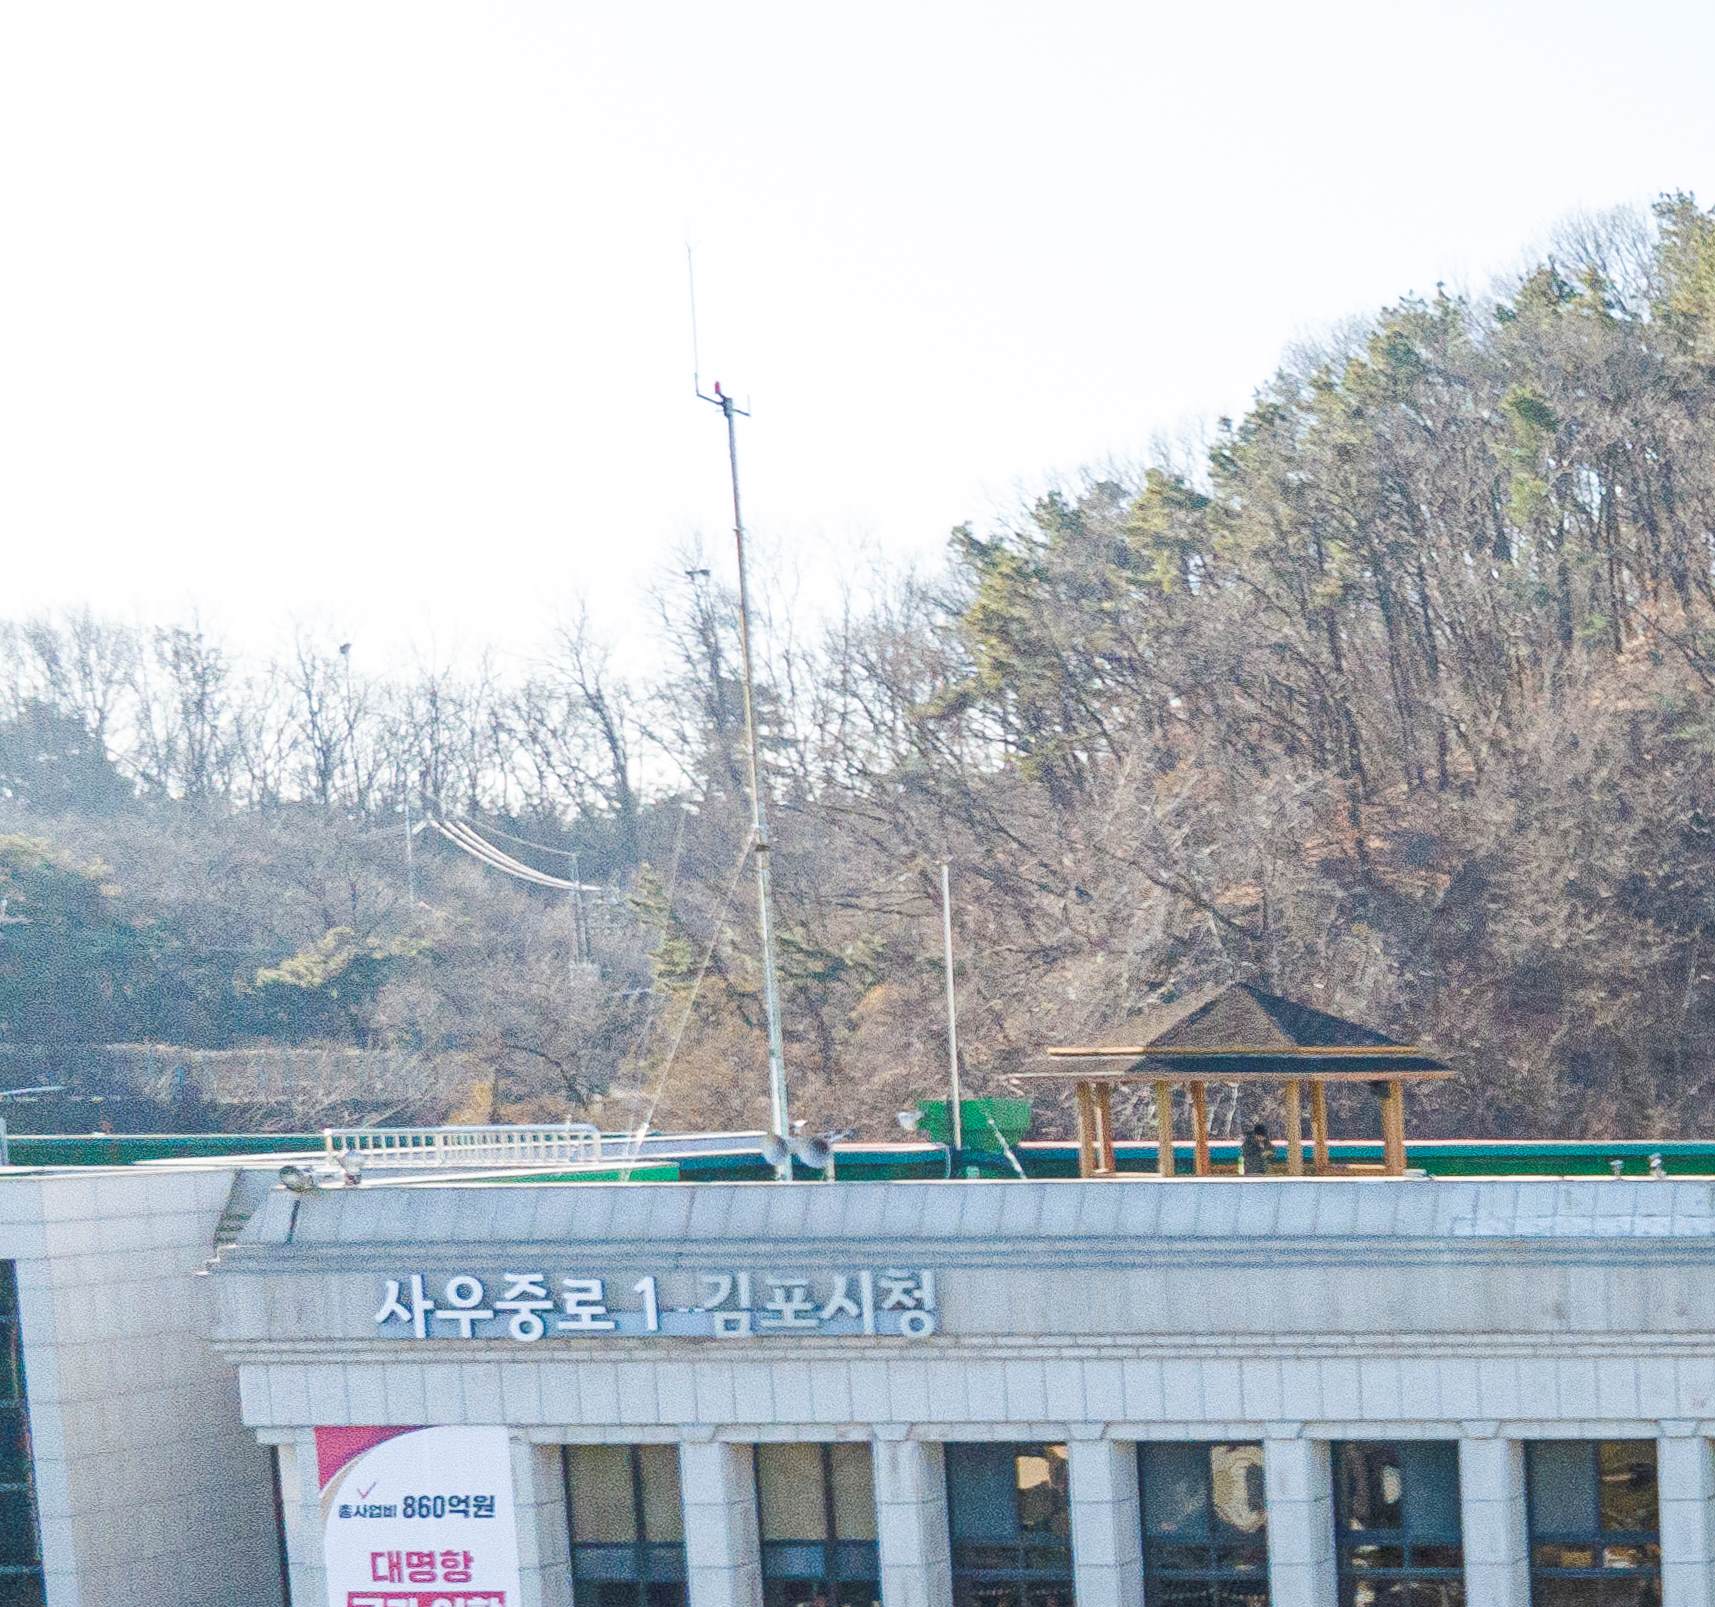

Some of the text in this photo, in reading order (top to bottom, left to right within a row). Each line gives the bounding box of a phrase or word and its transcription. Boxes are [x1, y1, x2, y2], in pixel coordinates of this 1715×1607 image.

[375, 1269, 937, 1342] 사우중로 1 김포시청
[338, 1494, 496, 1519] 총사업비 860억원
[369, 1550, 474, 1584] 대명항
